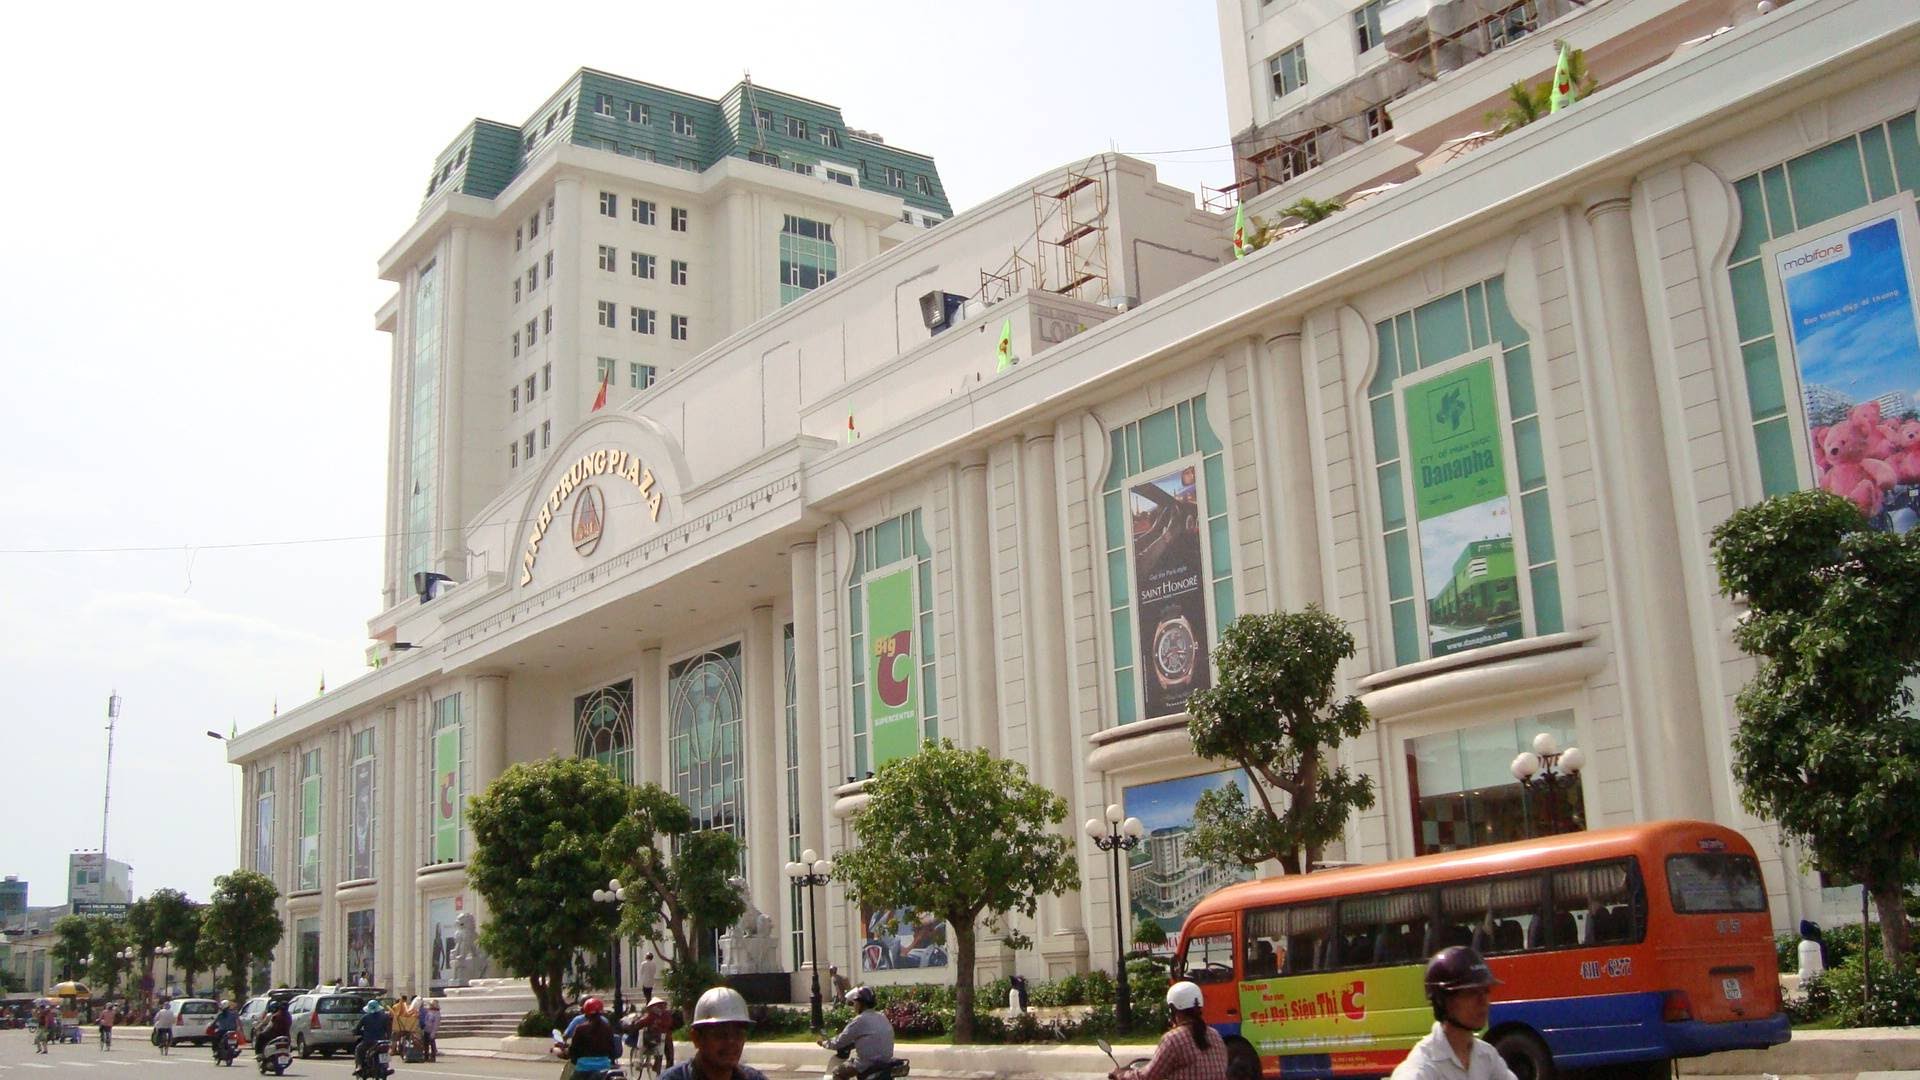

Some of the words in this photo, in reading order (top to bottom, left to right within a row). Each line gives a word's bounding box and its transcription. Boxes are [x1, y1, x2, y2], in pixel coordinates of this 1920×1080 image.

[1783, 242, 1844, 271] mobifone
[1421, 449, 1495, 488] Danapha
[521, 502, 553, 587] VINH
[550, 450, 608, 511] TRUNG
[607, 449, 663, 522] PLAZA
[1141, 587, 1163, 601] SAINT
[1446, 631, 1509, 650] www.danapha.com
[1317, 990, 1339, 1024] Thị
